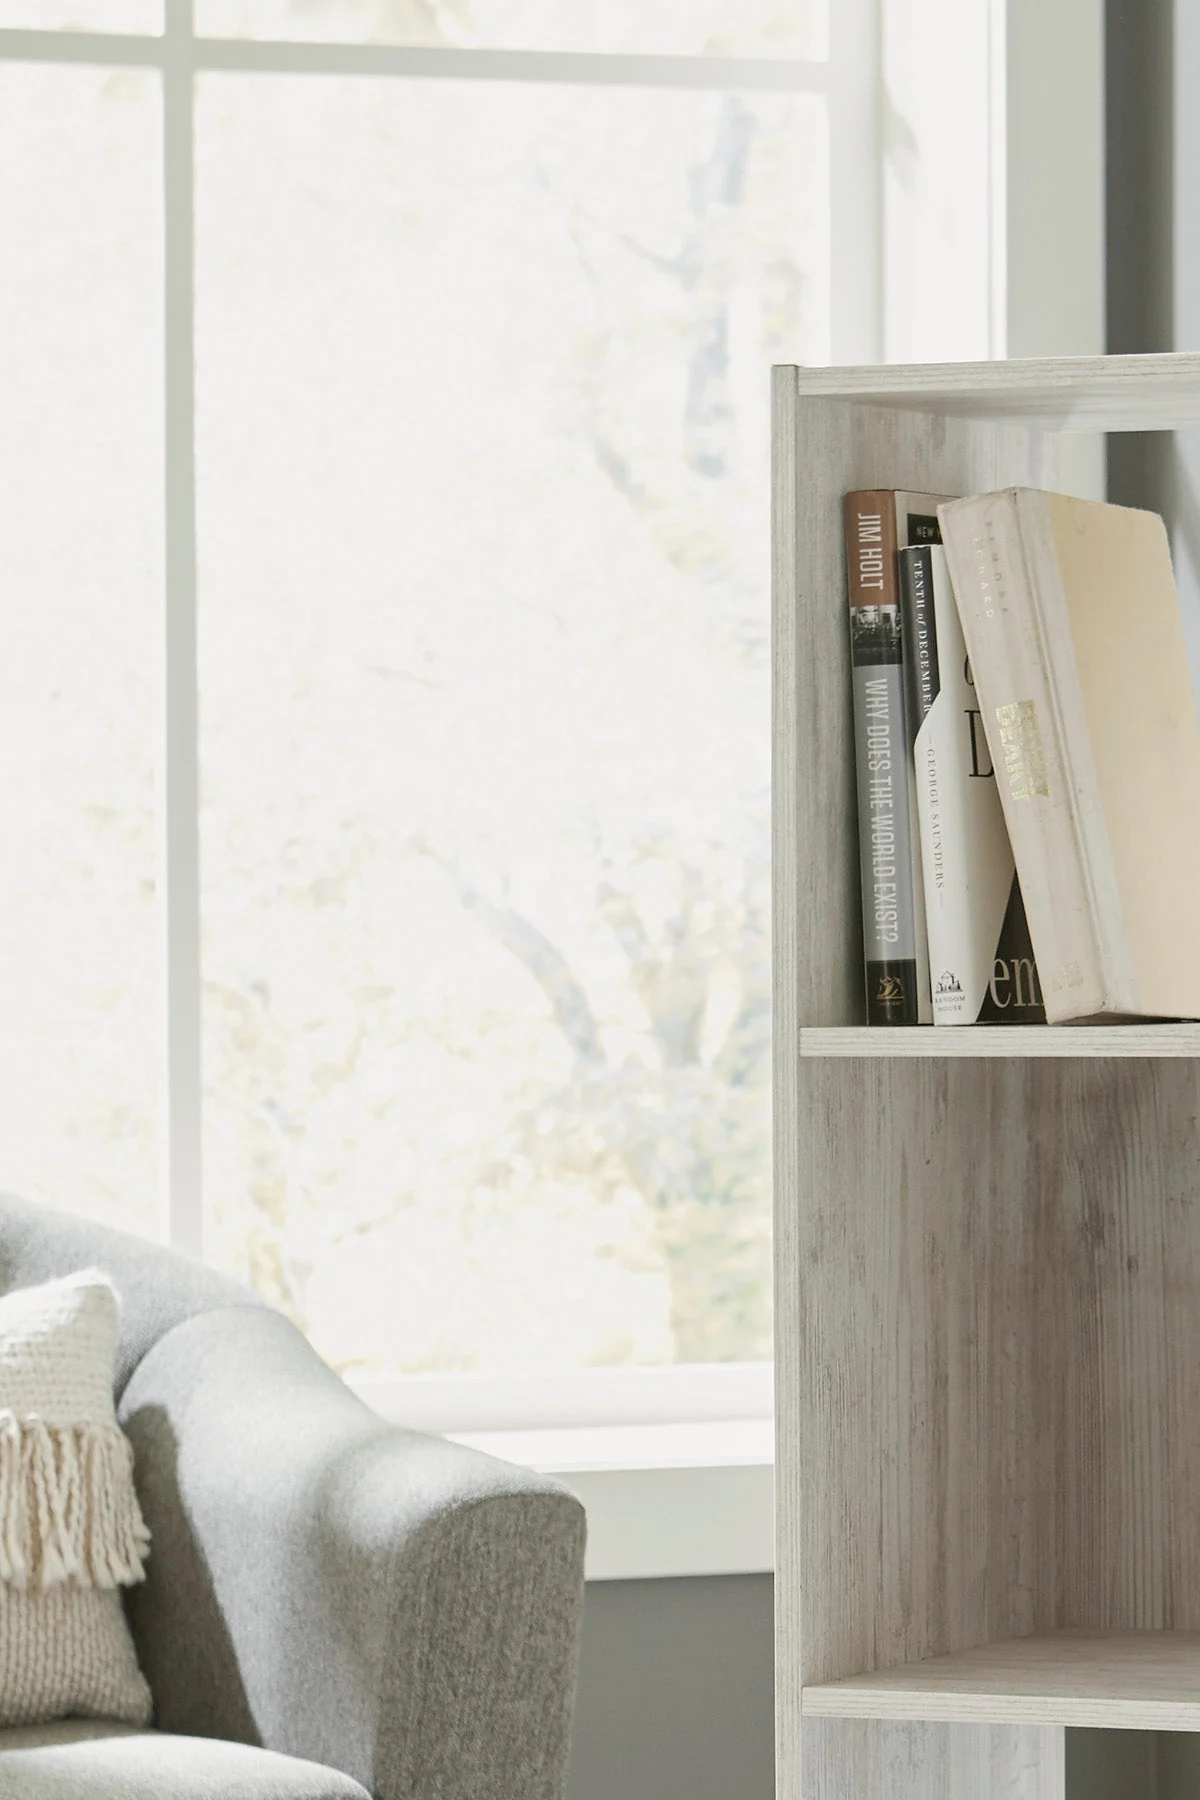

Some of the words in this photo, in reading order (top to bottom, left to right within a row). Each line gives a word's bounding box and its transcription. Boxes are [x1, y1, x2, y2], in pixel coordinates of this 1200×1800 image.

[858, 513, 883, 543] JIM
[916, 526, 934, 538] NEW
[859, 548, 885, 590] HOLT
[913, 560, 926, 609] TENTH
[915, 614, 925, 627] of
[917, 630, 933, 713] DECEMBER
[865, 678, 889, 720] WHY
[867, 725, 892, 772] DOES
[869, 776, 893, 809] THE
[926, 748, 939, 808] GEORGE
[871, 813, 896, 877] WORLD
[931, 813, 945, 889] SAUNDERS
[874, 883, 898, 944] EXIST?
